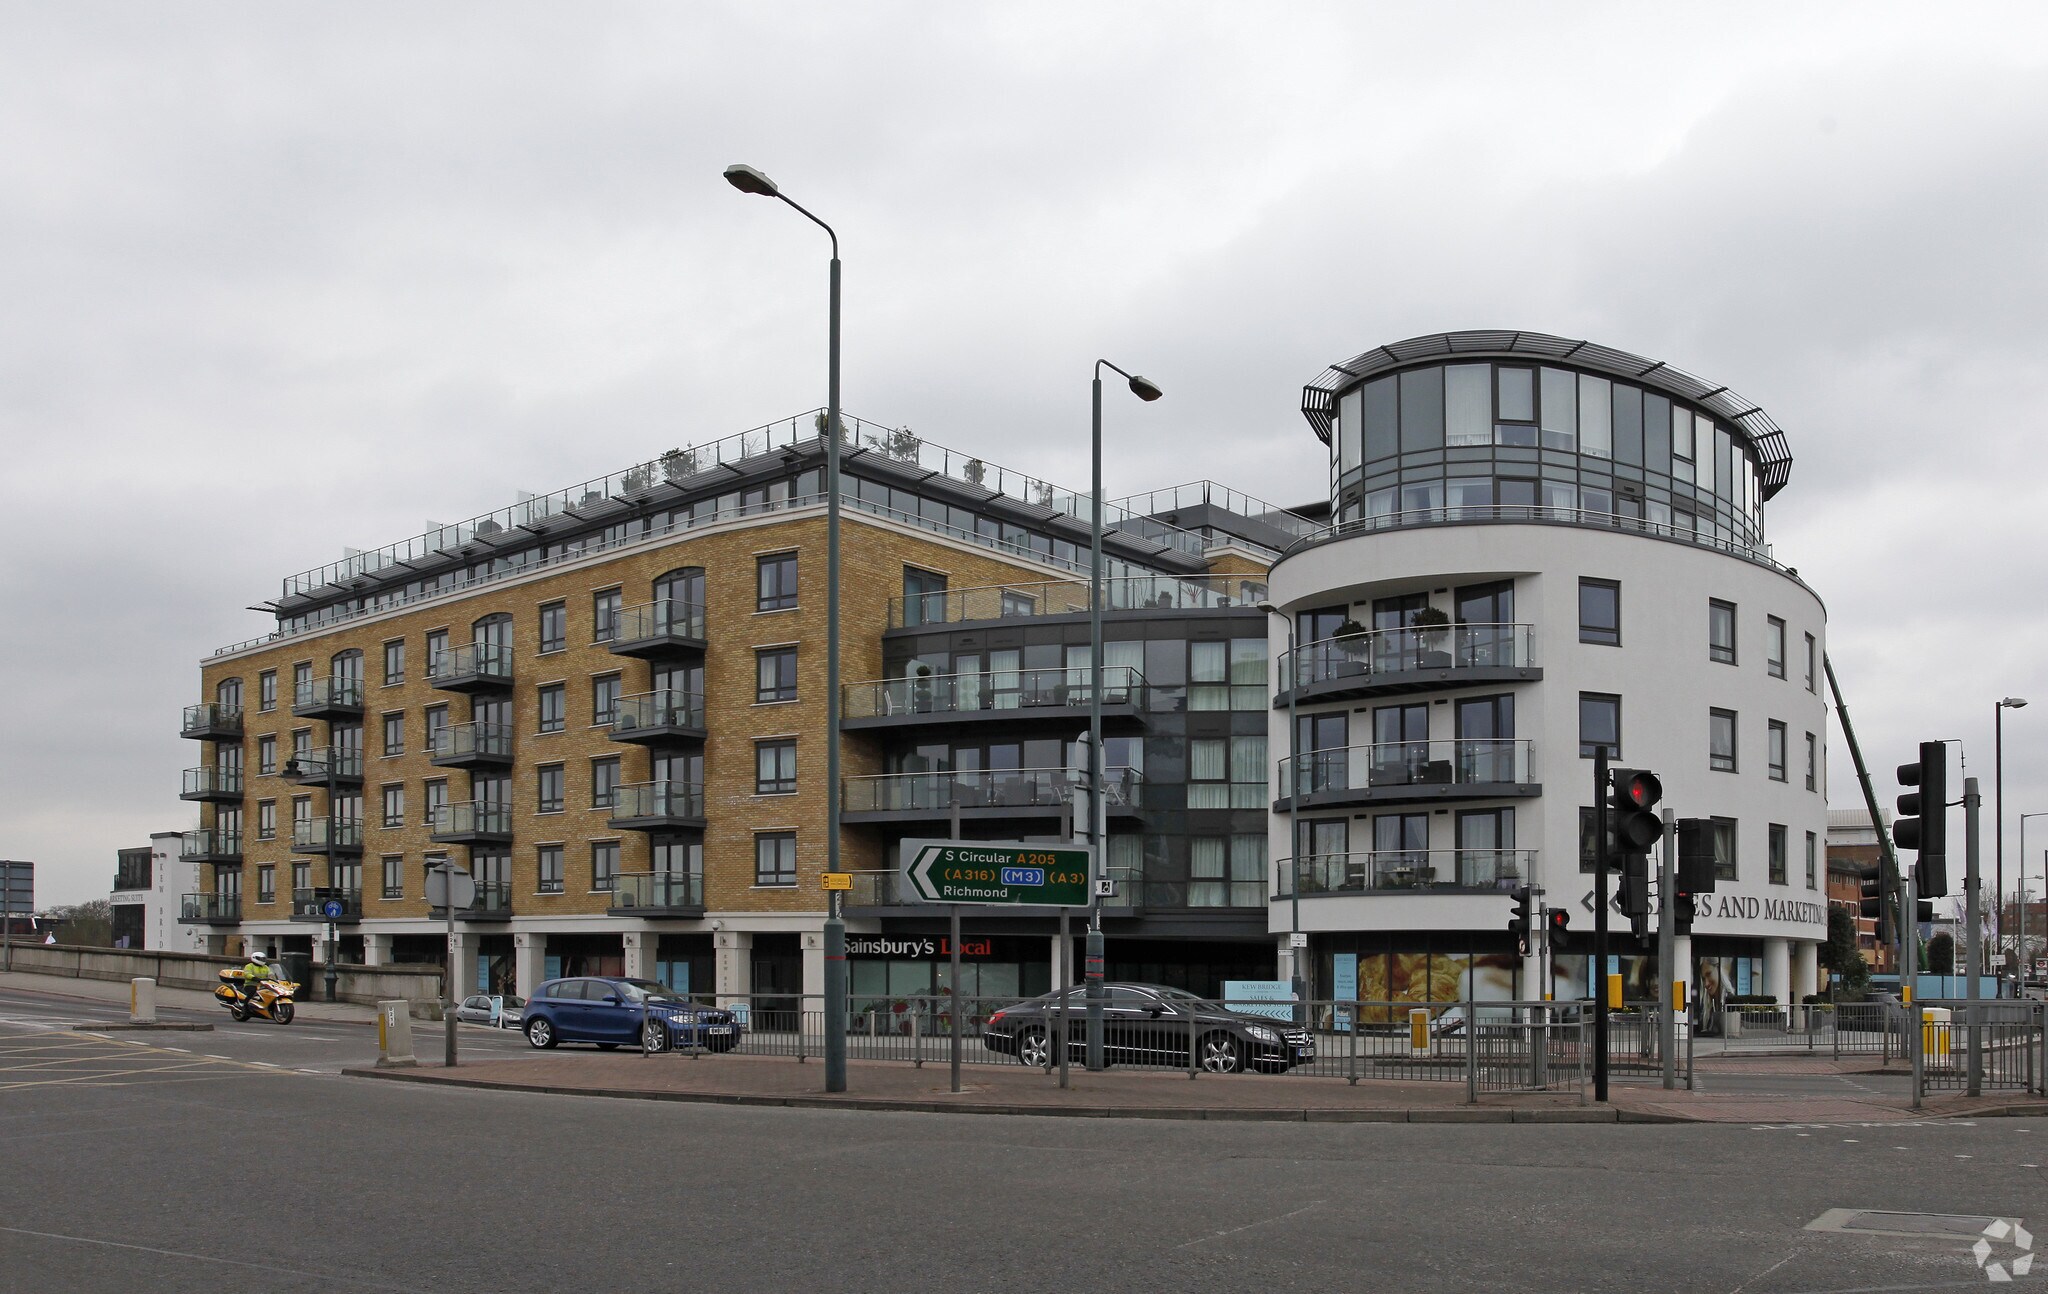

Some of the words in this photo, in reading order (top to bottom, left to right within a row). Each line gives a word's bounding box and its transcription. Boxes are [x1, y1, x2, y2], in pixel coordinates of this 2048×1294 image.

[945, 850, 954, 862] S
[959, 851, 1011, 863] Circular
[944, 885, 1008, 898] Richmond
[1717, 896, 1760, 920] AND
[845, 938, 934, 958] Sainsbury's
[940, 938, 991, 955] Lcal
